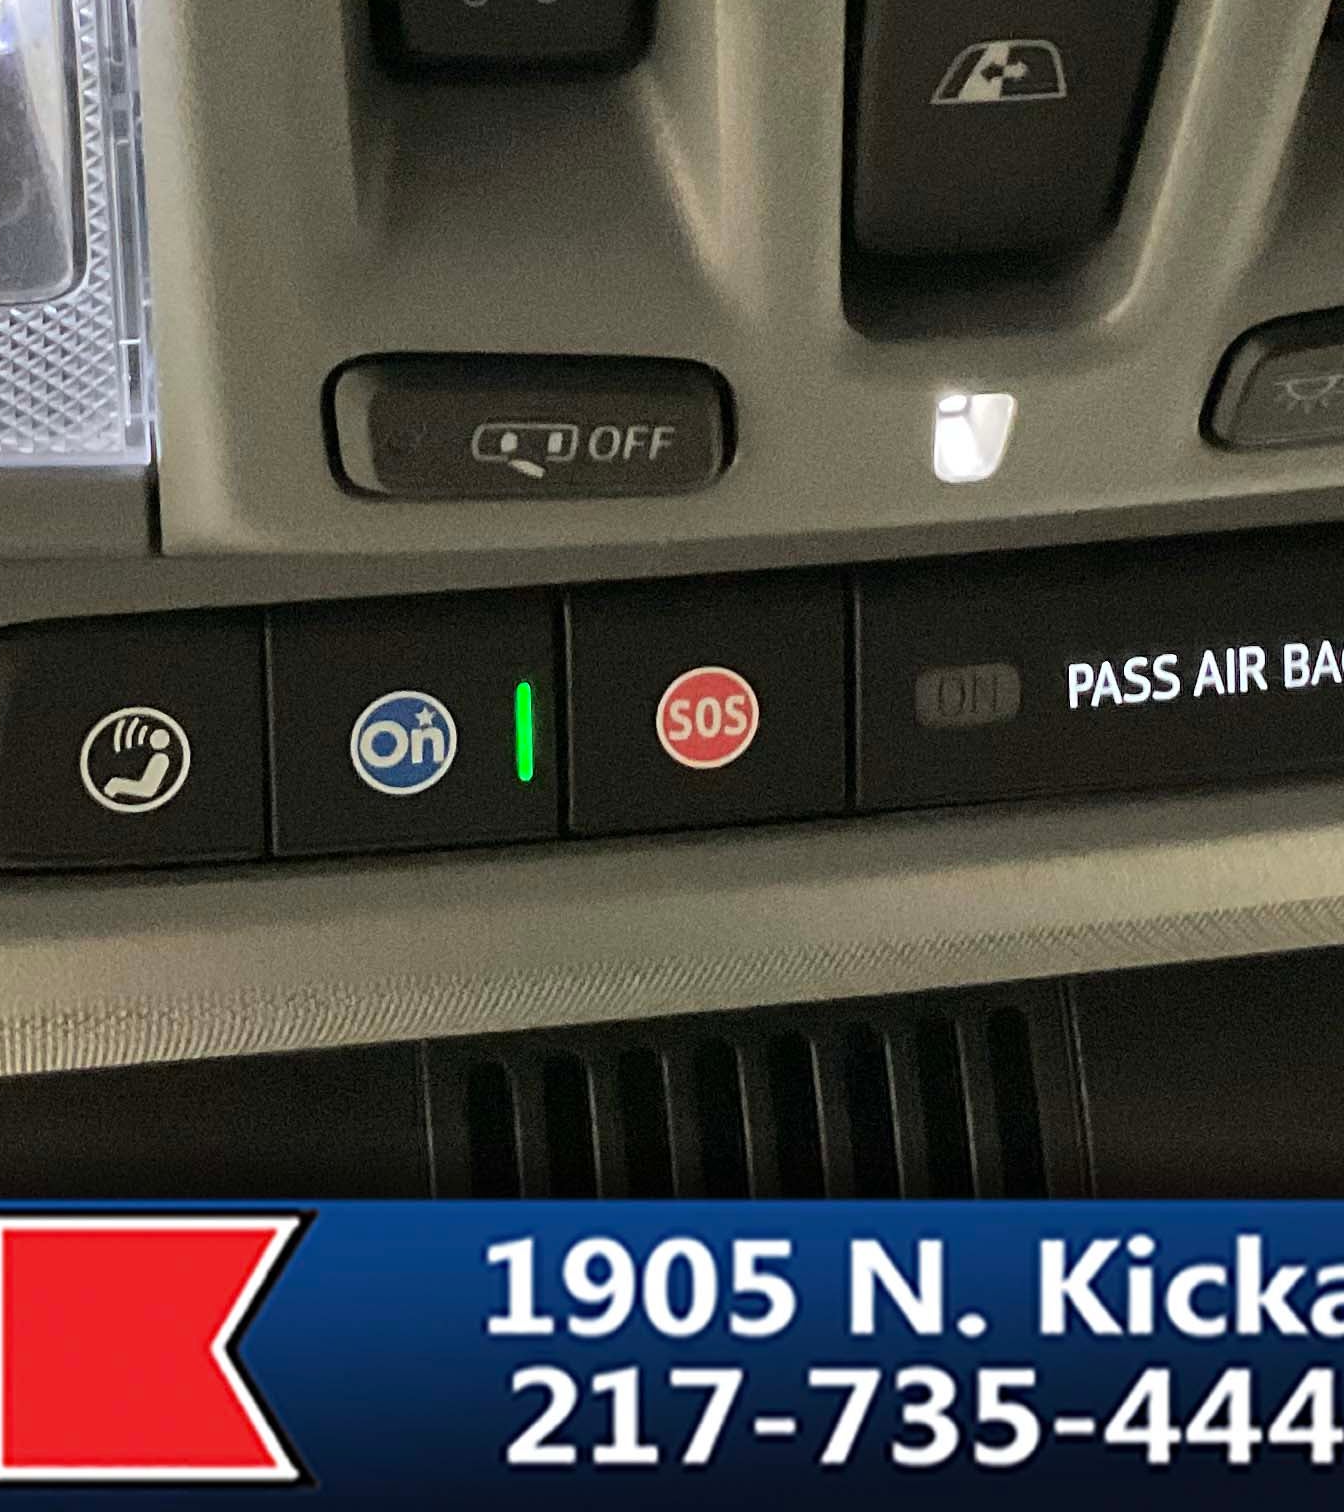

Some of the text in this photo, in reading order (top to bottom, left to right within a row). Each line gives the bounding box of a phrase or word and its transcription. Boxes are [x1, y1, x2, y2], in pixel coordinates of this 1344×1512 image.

[587, 425, 675, 462] OFF
[1067, 653, 1181, 709] PASS
[1192, 645, 1268, 698] AIR
[668, 694, 750, 742] SOS
